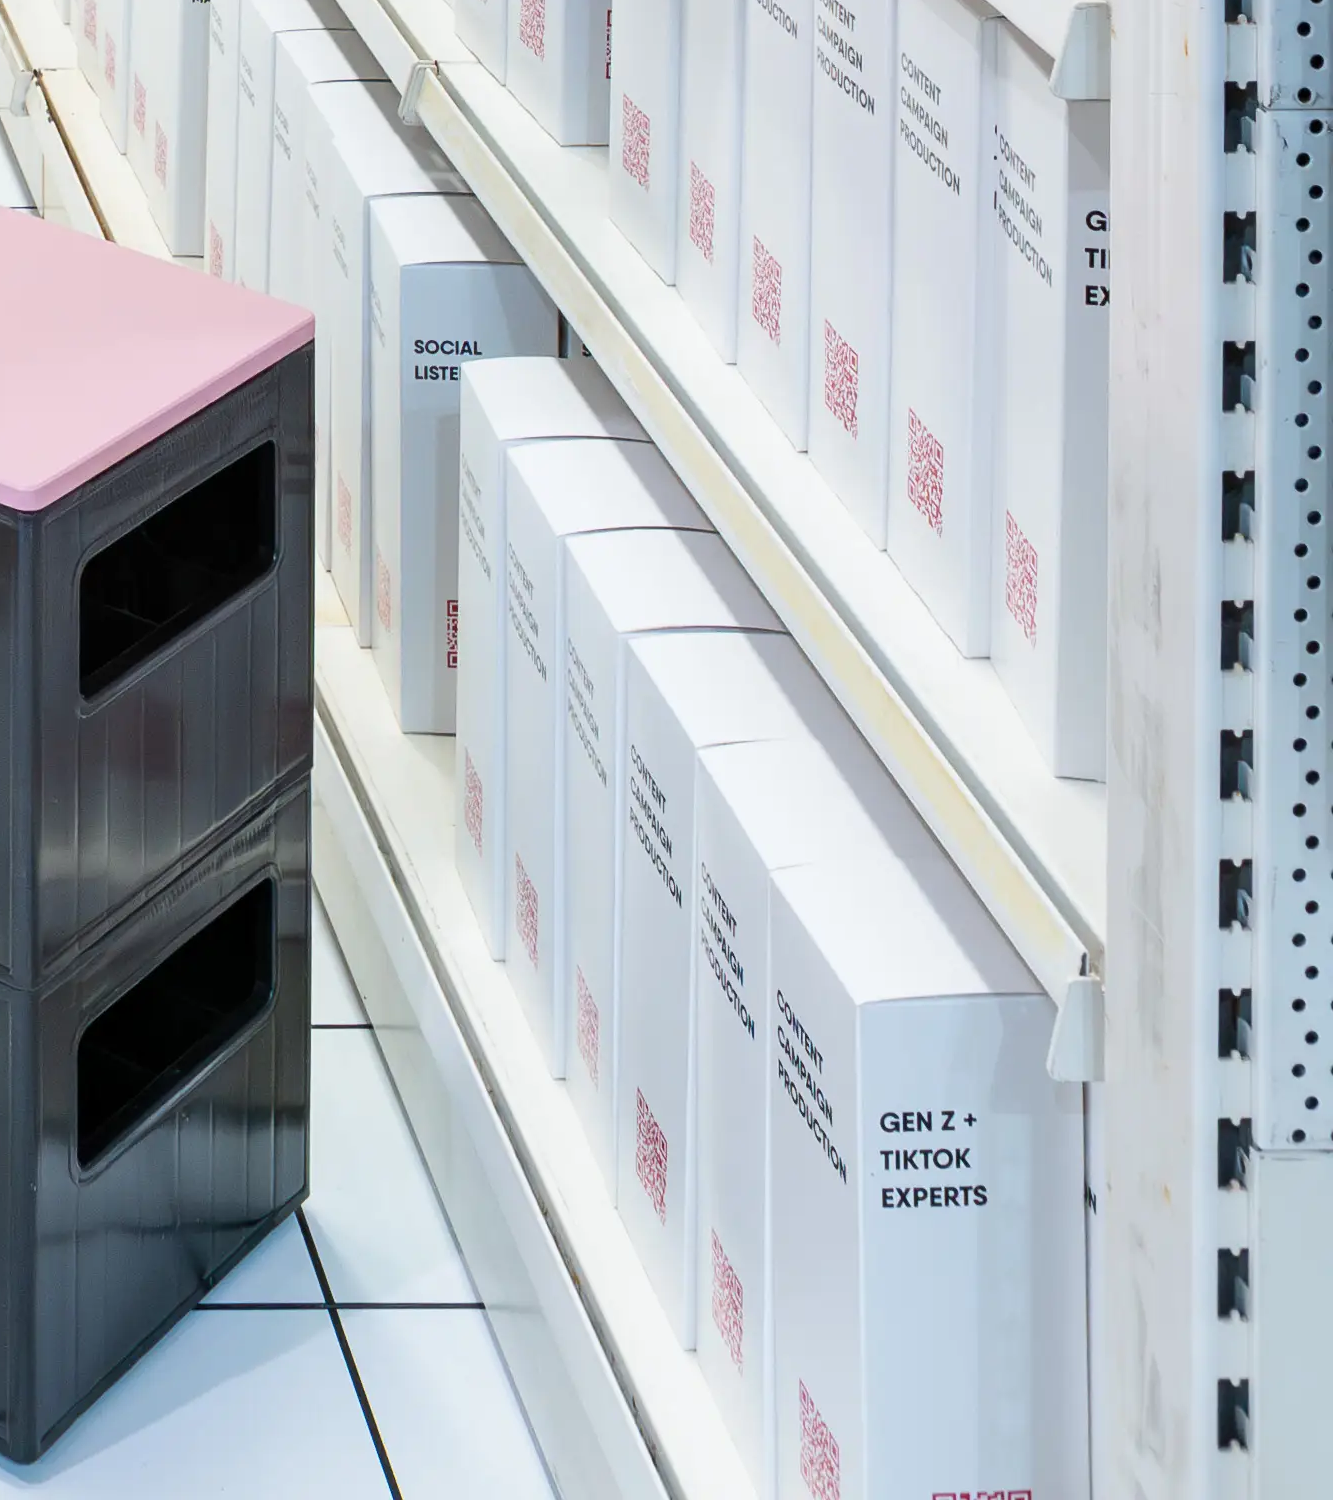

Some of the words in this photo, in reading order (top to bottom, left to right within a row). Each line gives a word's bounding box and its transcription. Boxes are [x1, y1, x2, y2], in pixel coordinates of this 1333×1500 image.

[901, 52, 941, 106] CONTENT
[900, 86, 947, 148] CAMPAIGN
[900, 118, 960, 196] PRODUCTION
[414, 340, 482, 356] SOCIAL
[415, 366, 462, 381] LISTE
[776, 989, 823, 1074] CONTENT
[777, 1025, 832, 1126] CAMPAIGN
[778, 1058, 846, 1184] PRODUCTION
[880, 1110, 933, 1133] GEN
[941, 1110, 956, 1133] Z
[962, 1113, 978, 1128] +
[879, 1147, 970, 1170] TIKTOK
[881, 1184, 987, 1208] EXPERTS
